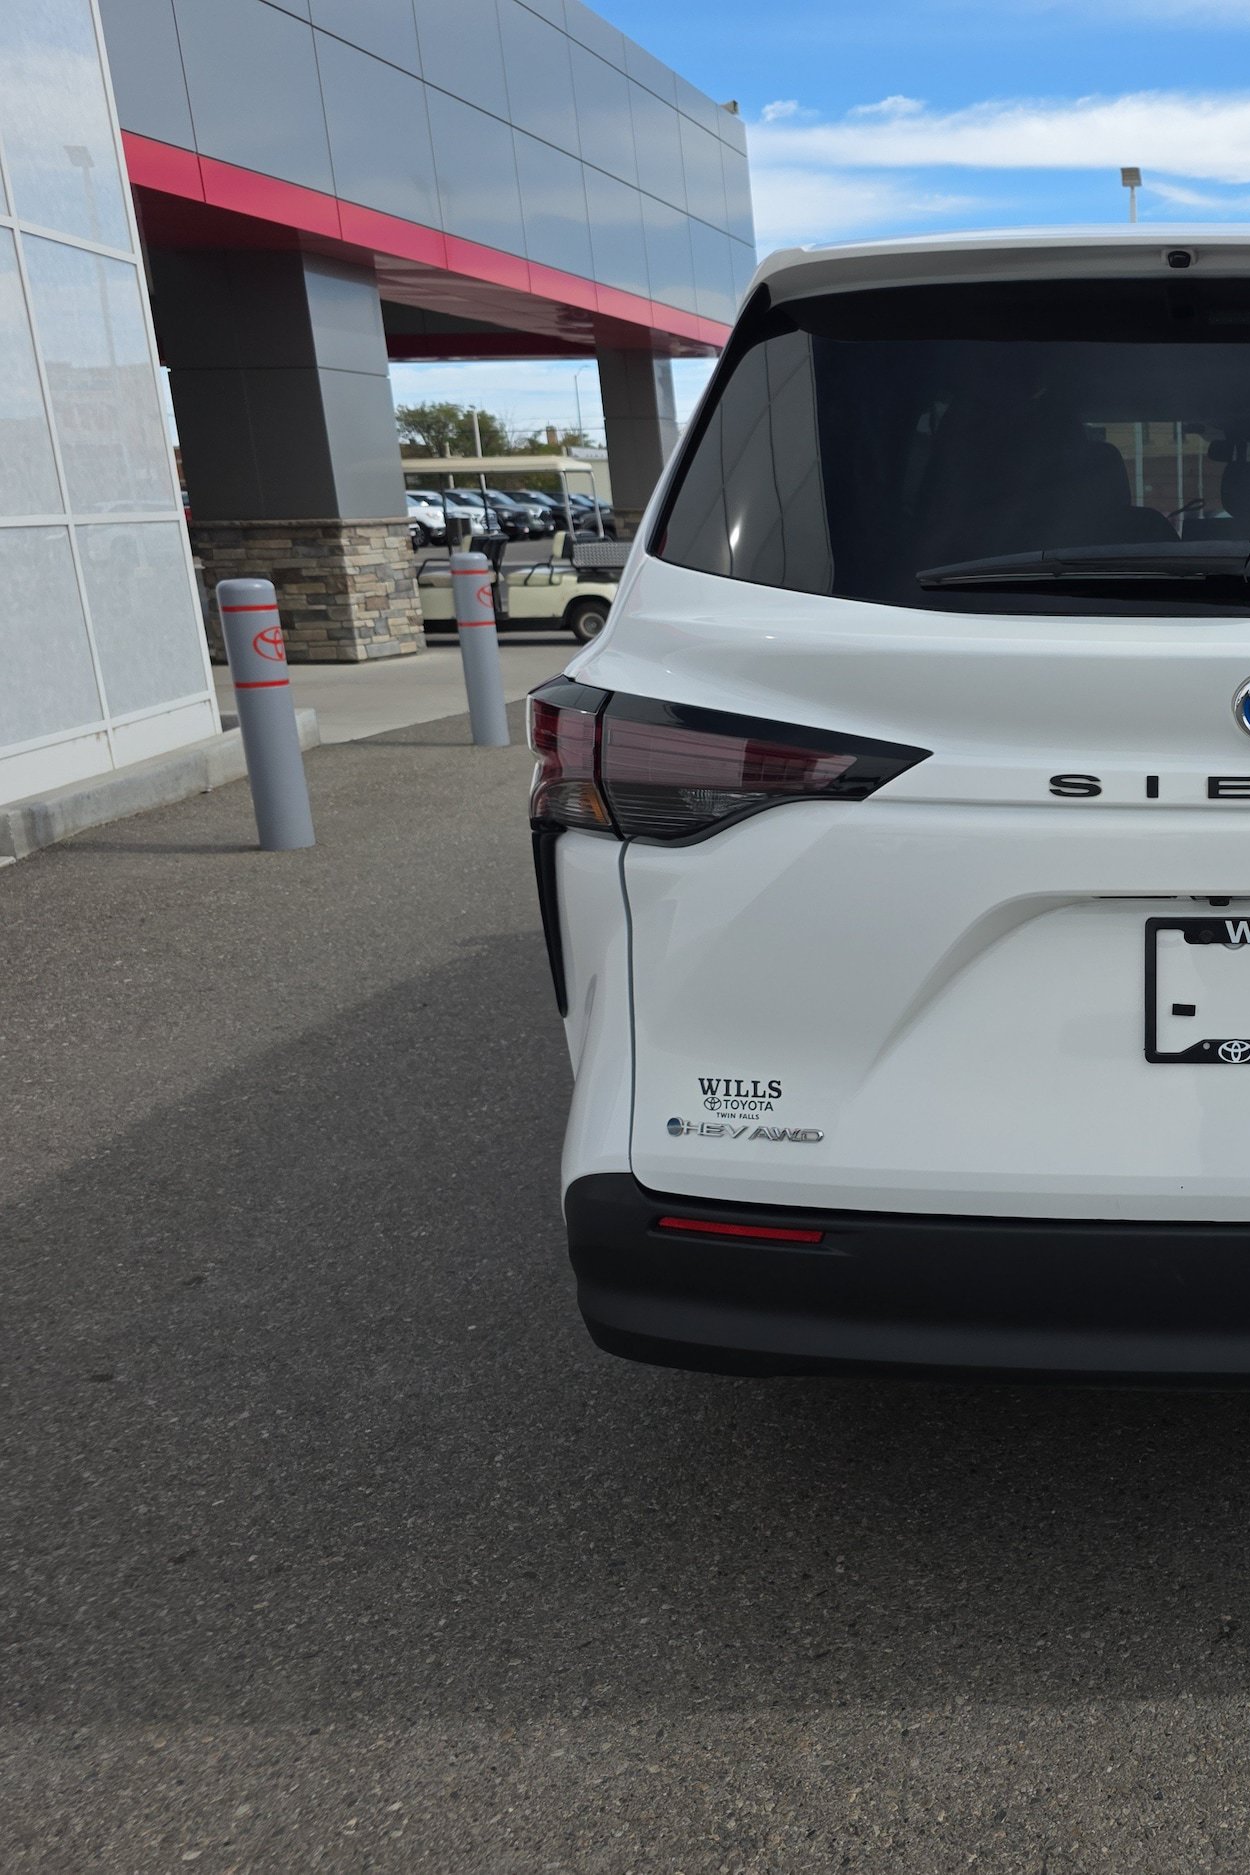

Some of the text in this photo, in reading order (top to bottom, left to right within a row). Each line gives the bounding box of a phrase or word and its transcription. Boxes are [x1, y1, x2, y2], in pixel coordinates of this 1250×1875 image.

[698, 1077, 782, 1099] WILLS
[723, 1099, 774, 1111] TOYOTA
[681, 1120, 824, 1143] HEV AWD
